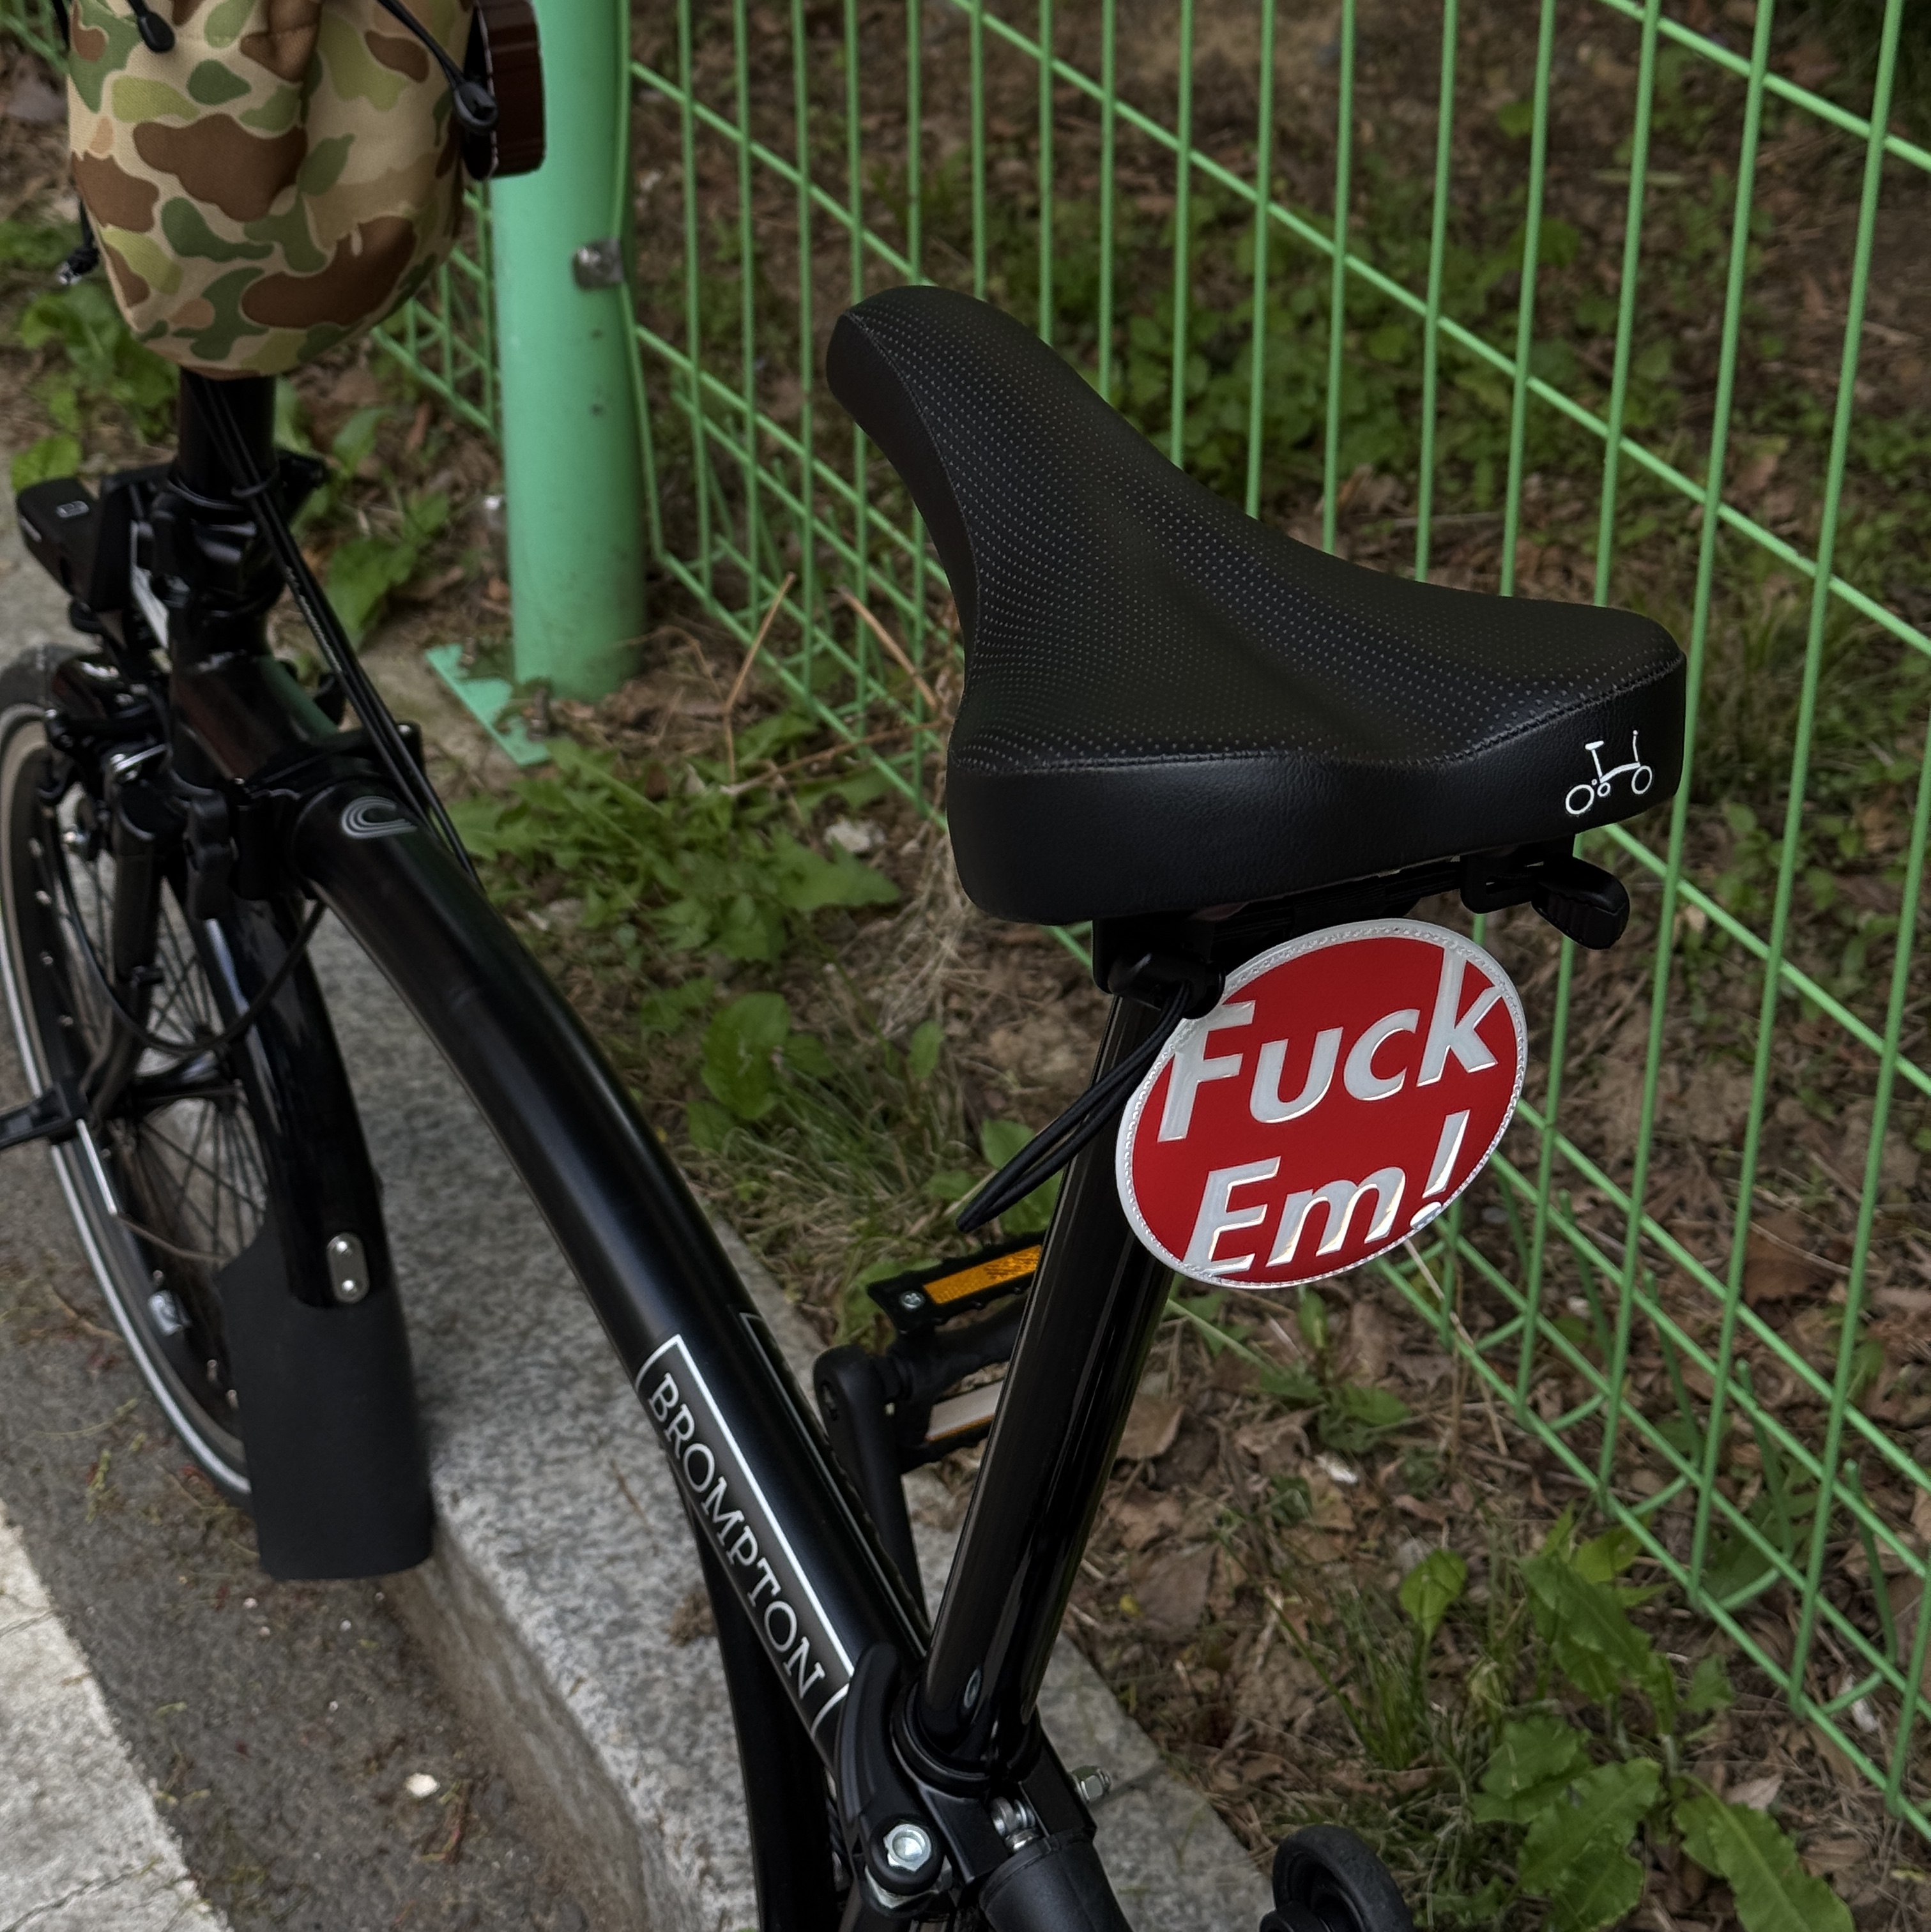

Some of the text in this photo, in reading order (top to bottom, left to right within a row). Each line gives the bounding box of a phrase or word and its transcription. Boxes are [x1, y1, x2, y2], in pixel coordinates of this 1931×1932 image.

[1157, 947, 1502, 1142] Fuck
[1182, 1109, 1470, 1275] Em!
[648, 1372, 825, 1699] BROMPTON
